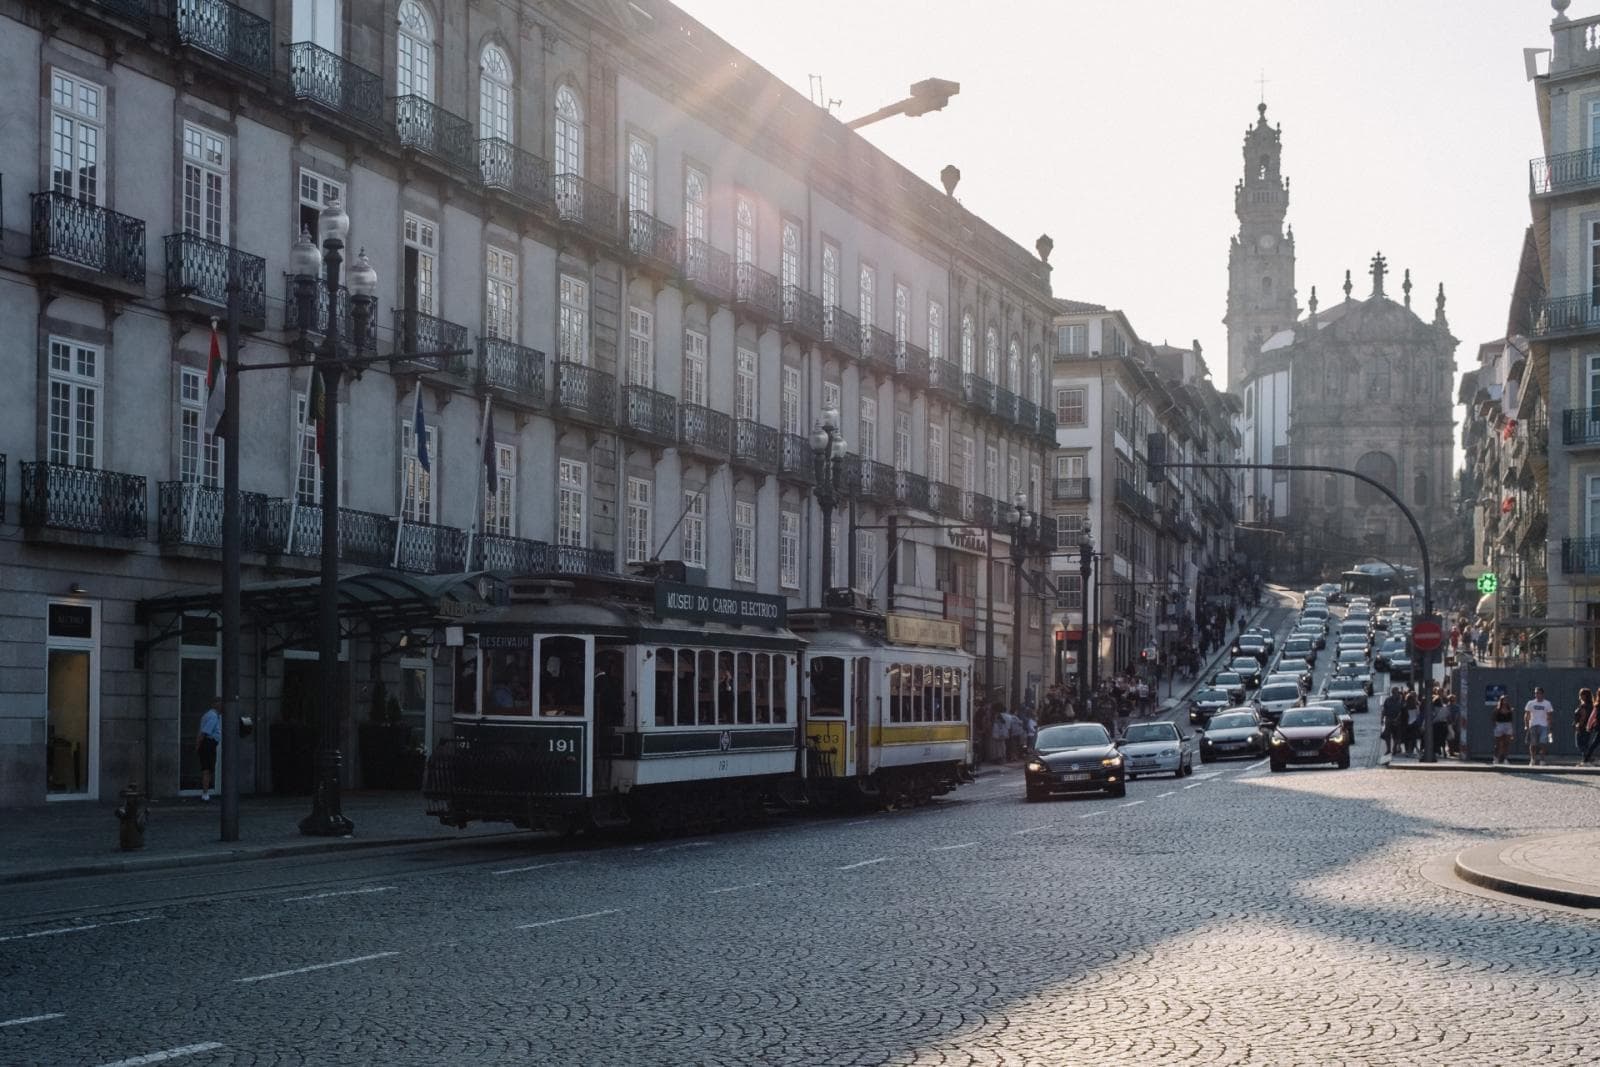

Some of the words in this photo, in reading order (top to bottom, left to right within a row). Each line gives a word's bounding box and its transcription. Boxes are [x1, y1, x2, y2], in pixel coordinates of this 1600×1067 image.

[667, 591, 695, 609] MUSEU
[697, 594, 710, 611] DO
[712, 597, 738, 614] CARRO
[740, 600, 778, 617] ELECTRICO
[480, 635, 529, 648] RESERVADO
[549, 739, 575, 752] 191
[815, 734, 840, 744] 203
